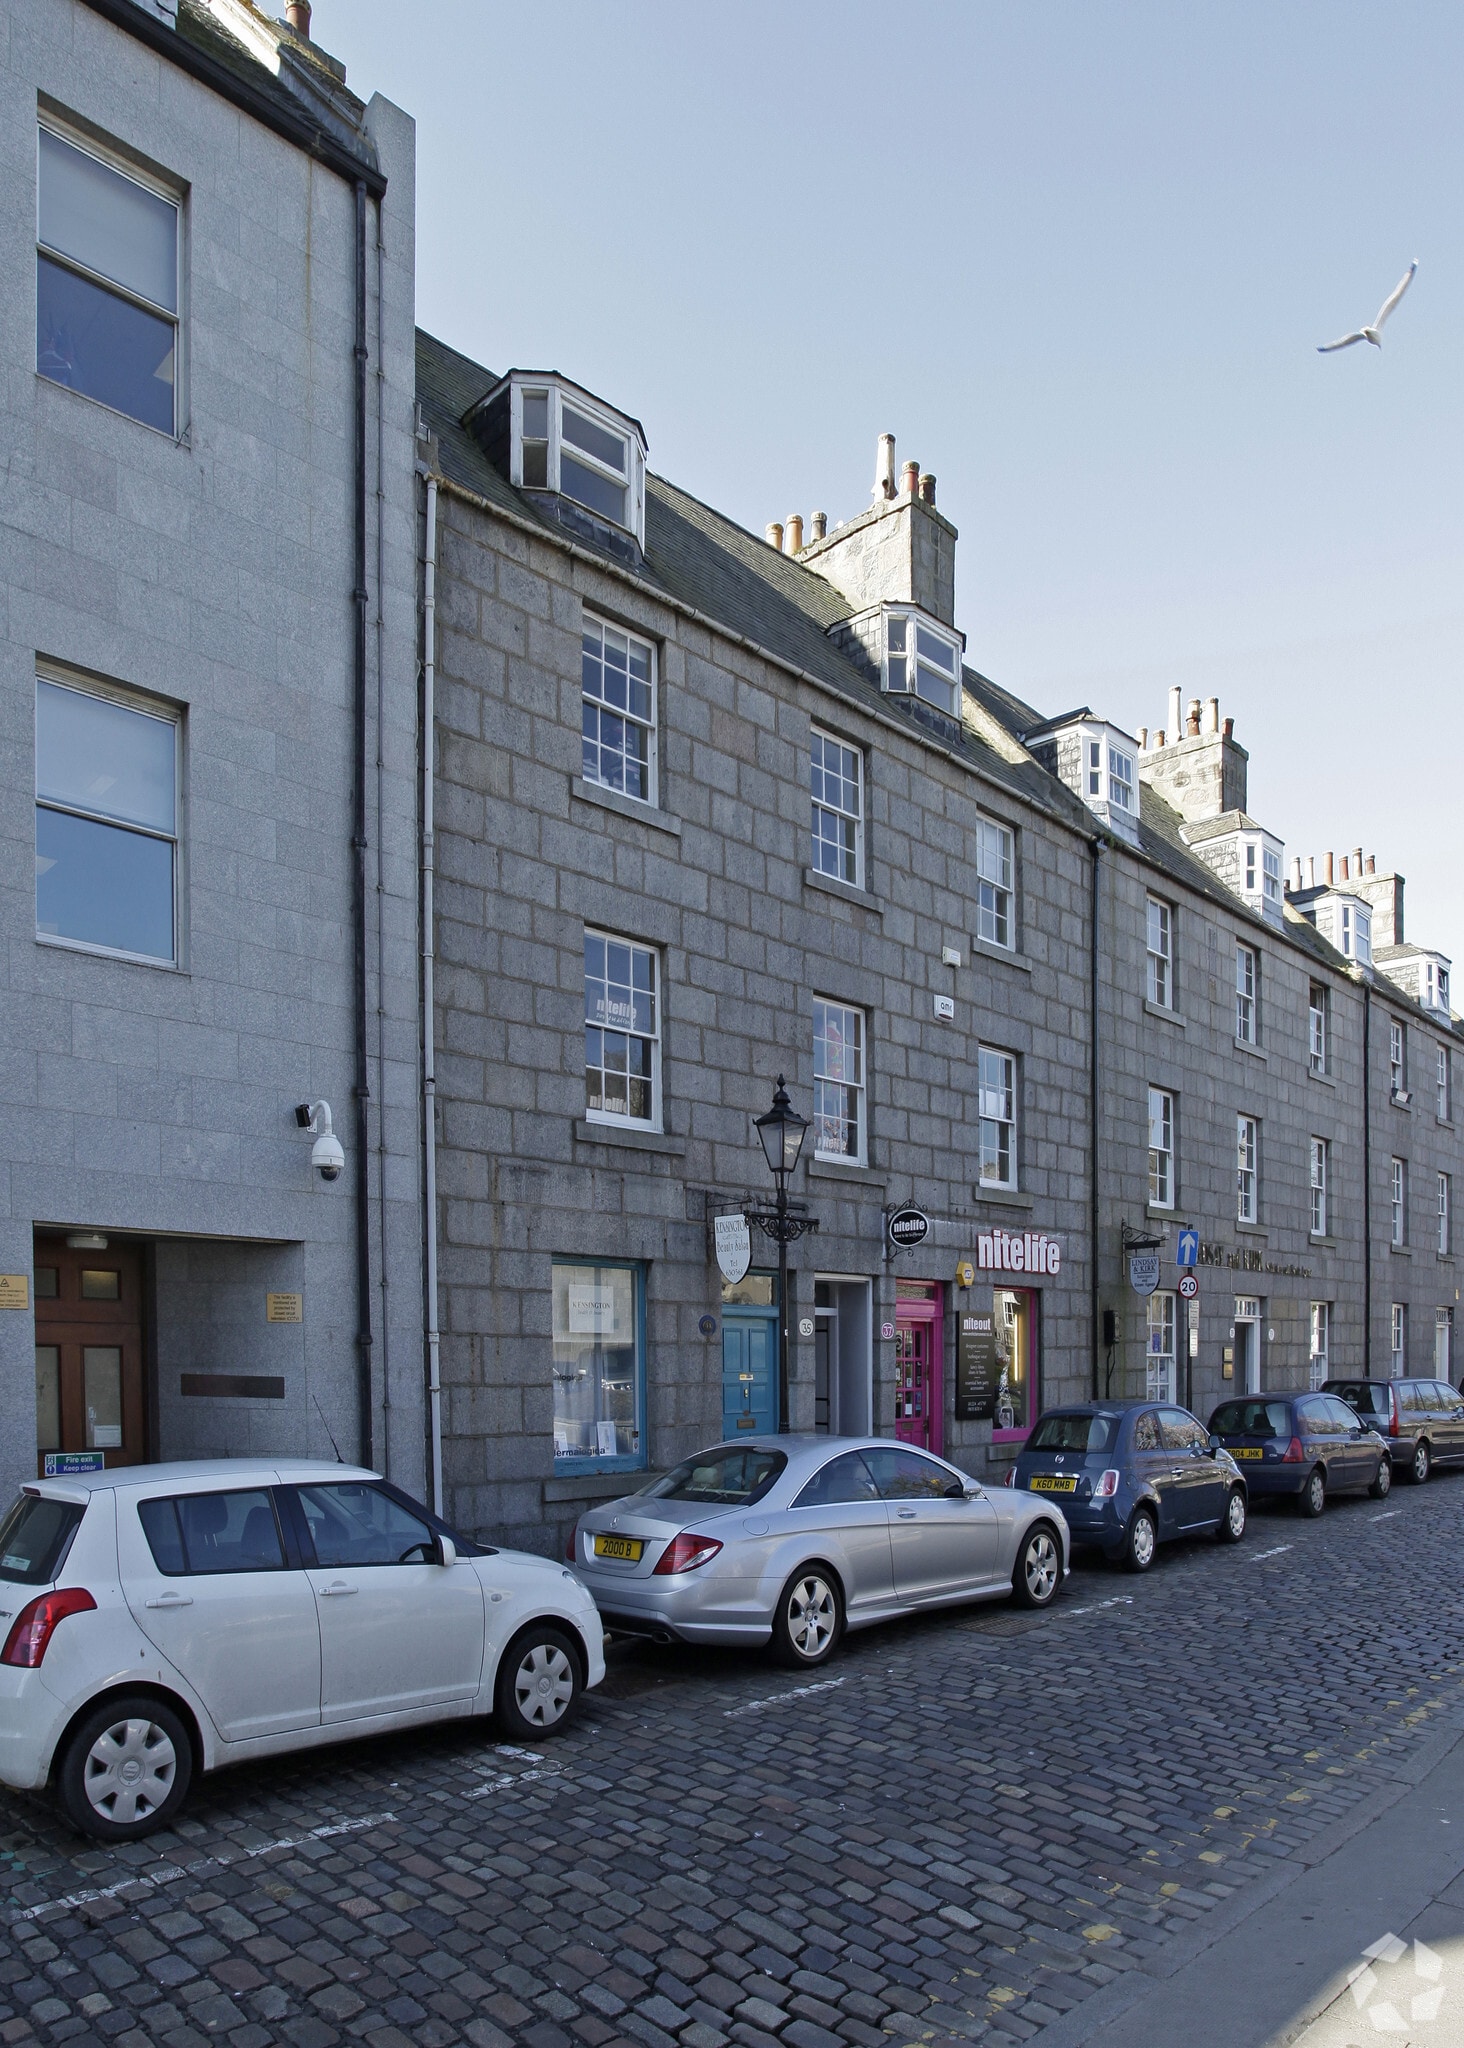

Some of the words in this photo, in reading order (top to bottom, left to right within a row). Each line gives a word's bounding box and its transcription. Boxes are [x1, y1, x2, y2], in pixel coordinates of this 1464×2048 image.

[596, 999, 637, 1020] ntelife
[716, 1219, 748, 1233] KENSINGTO
[894, 1219, 925, 1232] nitelife
[977, 1229, 1060, 1274] nitelife
[1132, 1258, 1157, 1266] LINDSAY
[1182, 1282, 1195, 1291] 20
[572, 1301, 610, 1309] KENSINGTON
[803, 1324, 811, 1333] 35
[963, 1317, 991, 1330] niteout
[1229, 1450, 1244, 1458] 804
[1036, 1480, 1052, 1489] K60
[603, 1540, 624, 1555] 2000
[626, 1544, 632, 1556] B
